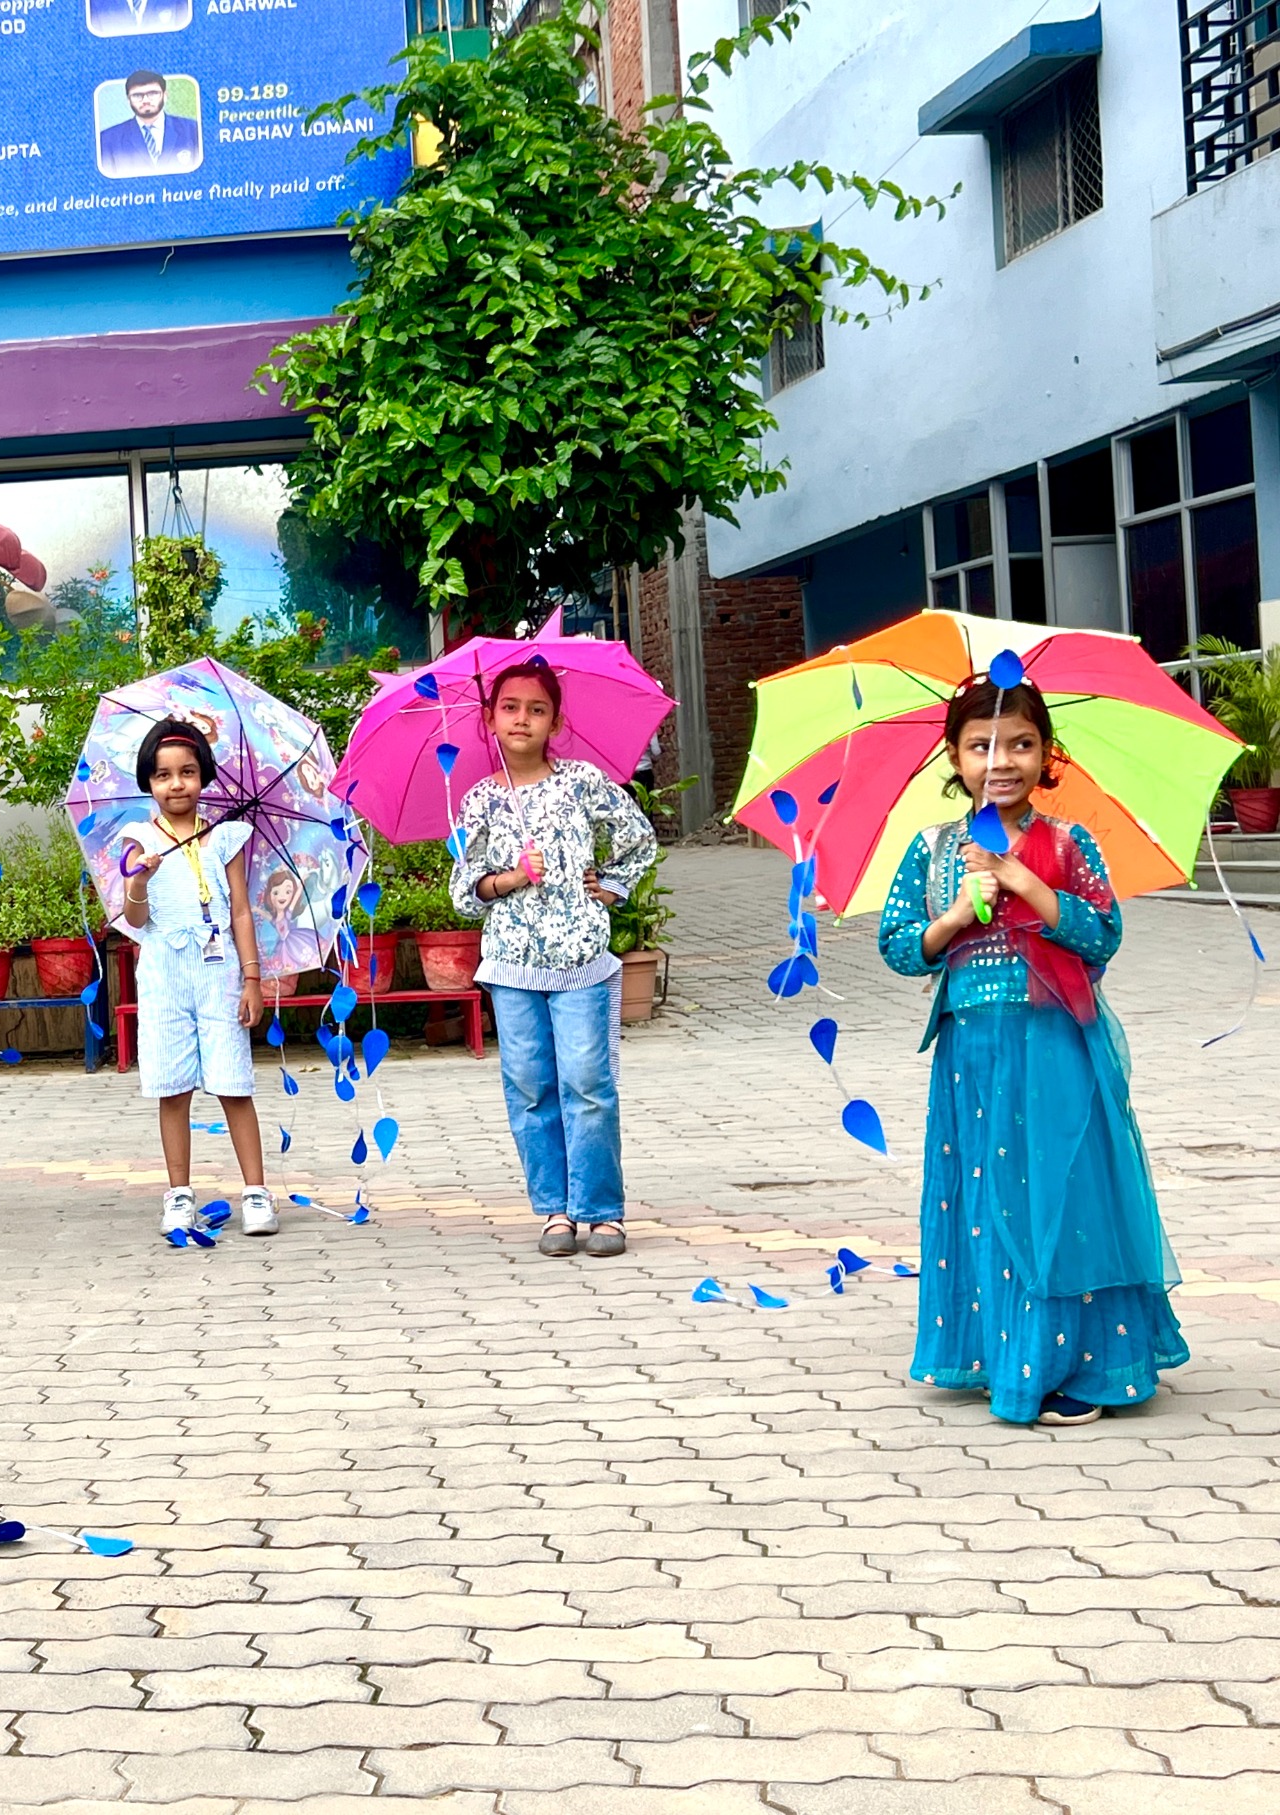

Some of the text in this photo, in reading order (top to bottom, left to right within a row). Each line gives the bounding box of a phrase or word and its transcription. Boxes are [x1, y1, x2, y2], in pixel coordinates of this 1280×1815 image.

[206, 0, 298, 15] AGARWAL
[217, 83, 288, 103] 99.189
[219, 123, 294, 143] RAGHAV
[24, 196, 57, 215] and
[63, 194, 155, 212] dedication
[162, 187, 203, 203] have
[209, 180, 265, 201] finally
[270, 177, 310, 197] paid
[315, 174, 347, 192] off.
